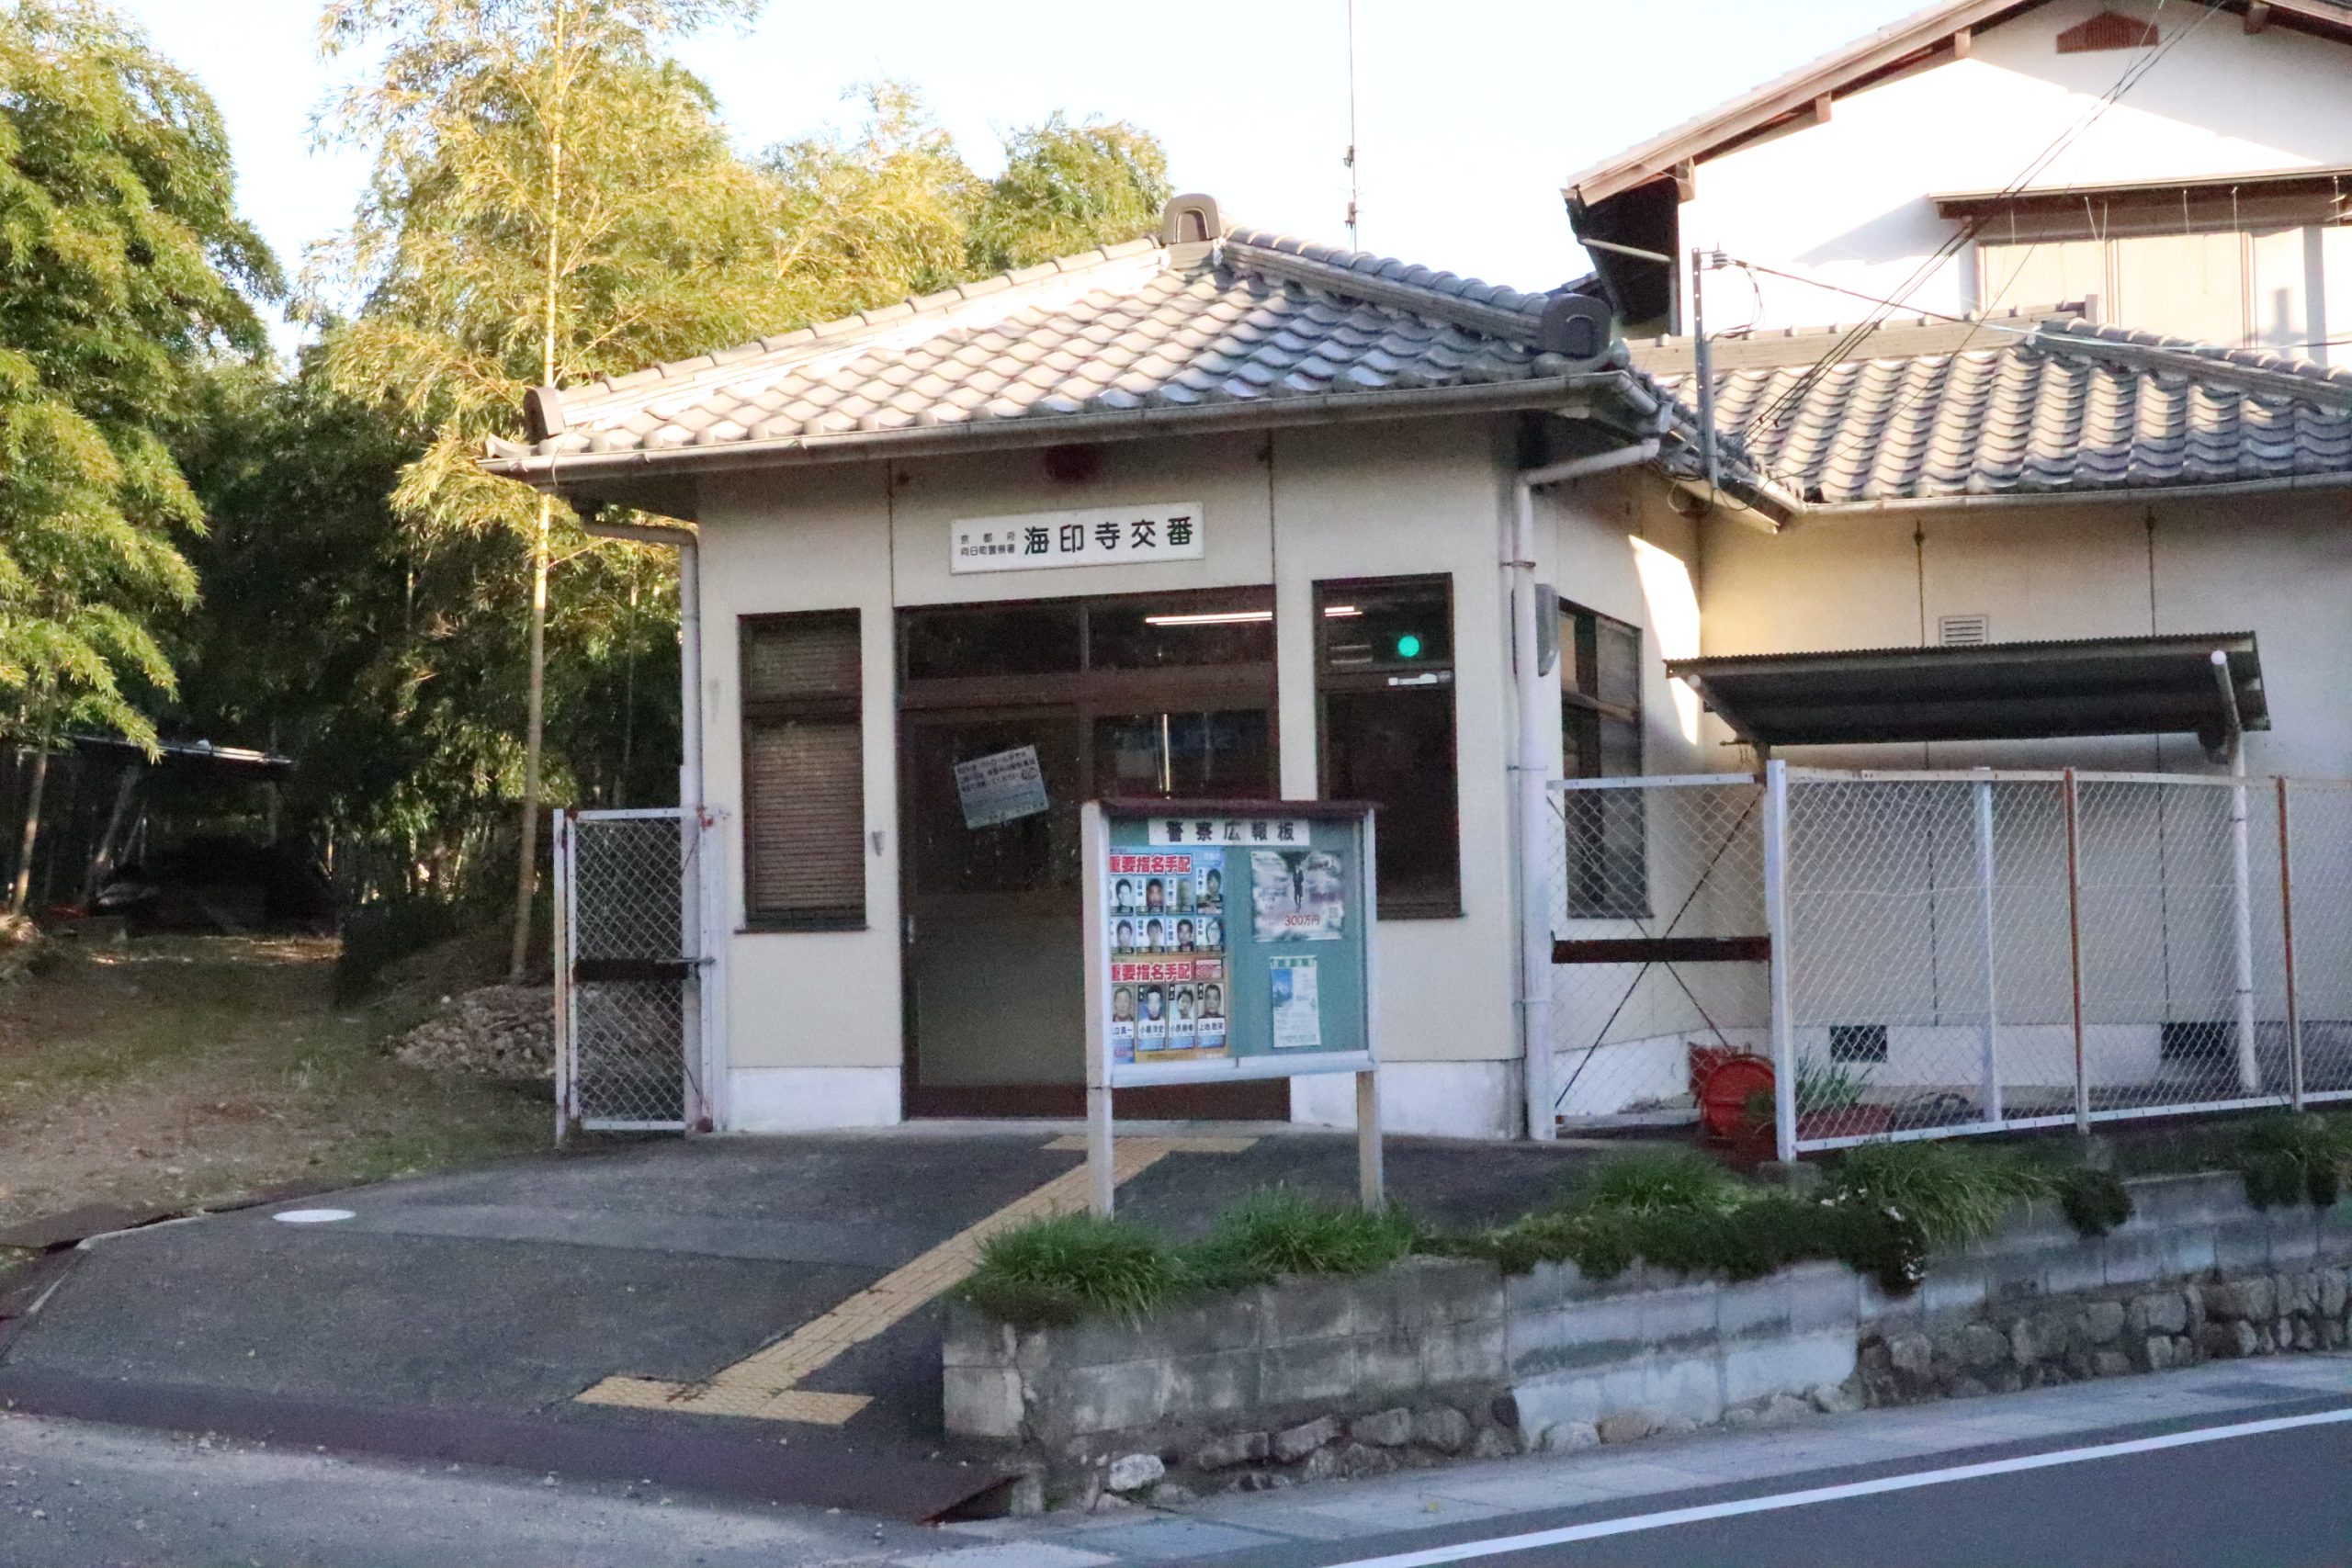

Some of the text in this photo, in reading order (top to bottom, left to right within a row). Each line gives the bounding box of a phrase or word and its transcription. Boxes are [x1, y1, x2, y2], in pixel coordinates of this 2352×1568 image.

[961, 531, 1015, 544] 京都府
[1023, 516, 1193, 556] 海印寺交番
[961, 544, 1015, 557] 向日町警察署
[1166, 820, 1295, 842] 警察広報板
[1110, 855, 1191, 874] 重要指名手配
